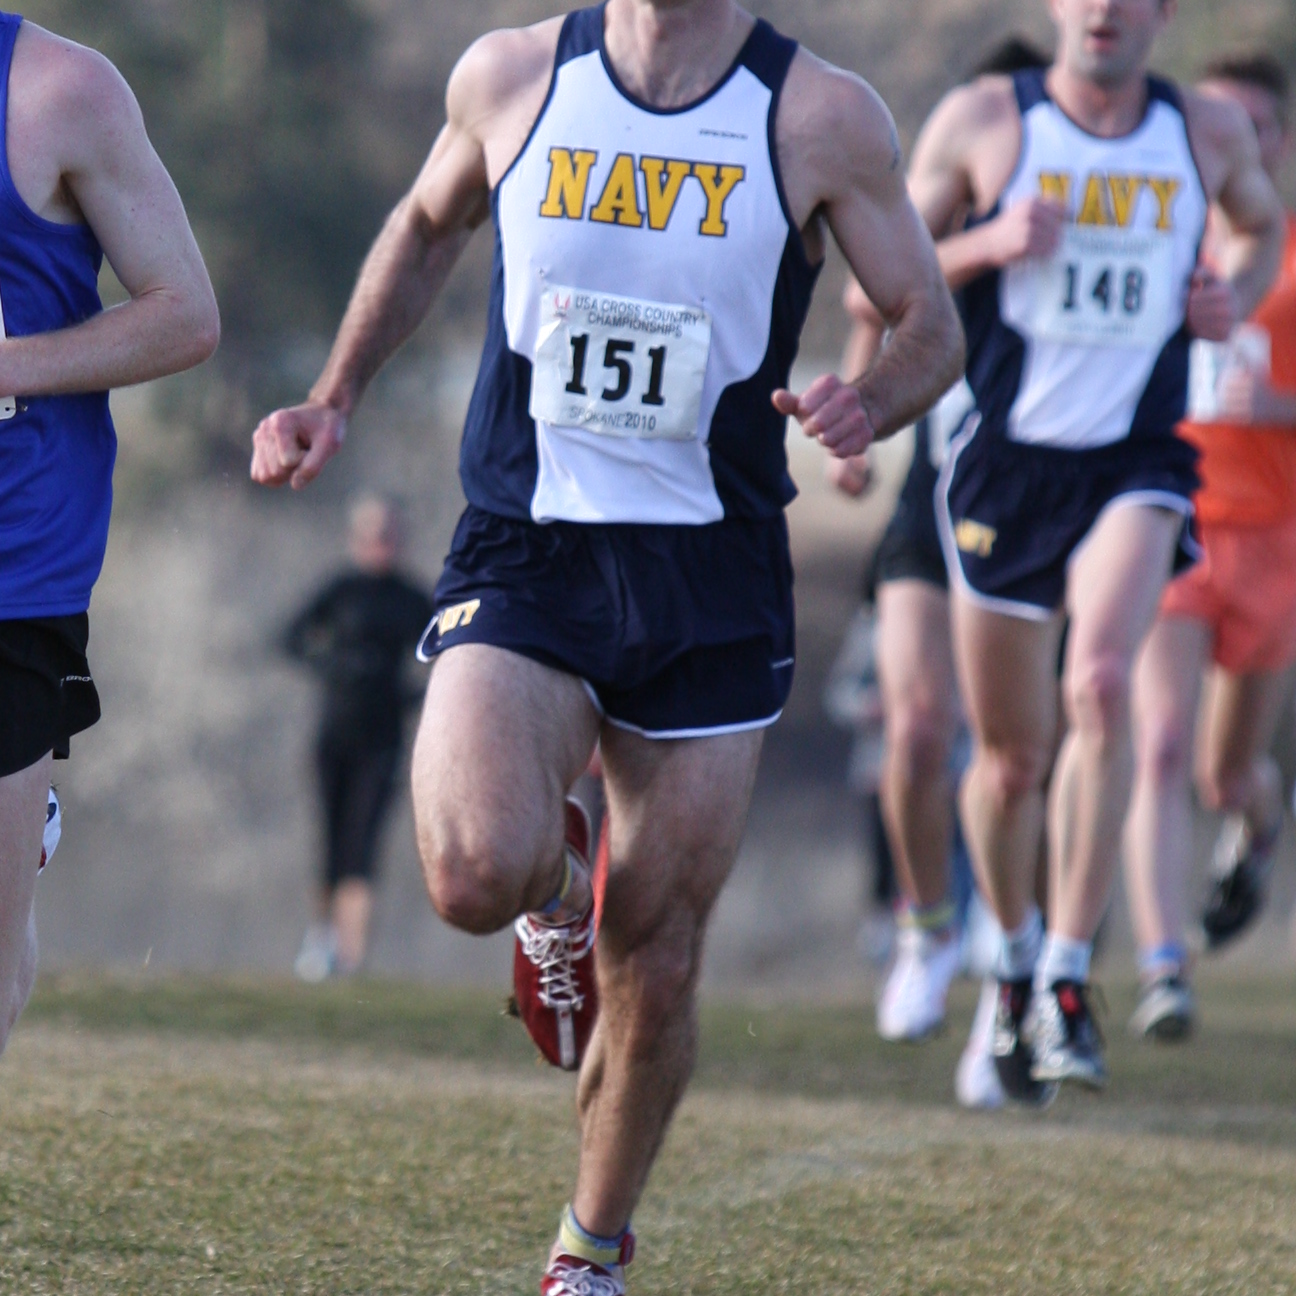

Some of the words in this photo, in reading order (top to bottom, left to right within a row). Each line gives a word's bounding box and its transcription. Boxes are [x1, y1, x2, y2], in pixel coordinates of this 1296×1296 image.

[539, 147, 746, 237] NAVY
[1061, 262, 1146, 315] 148
[575, 296, 598, 312] USA
[601, 299, 641, 317] CROSS
[645, 306, 700, 326] COUNTRY
[588, 312, 683, 338] CHAMPIONSHIPS
[565, 332, 667, 406] 151
[569, 406, 625, 428] SPOKANE
[625, 411, 657, 432] 2010
